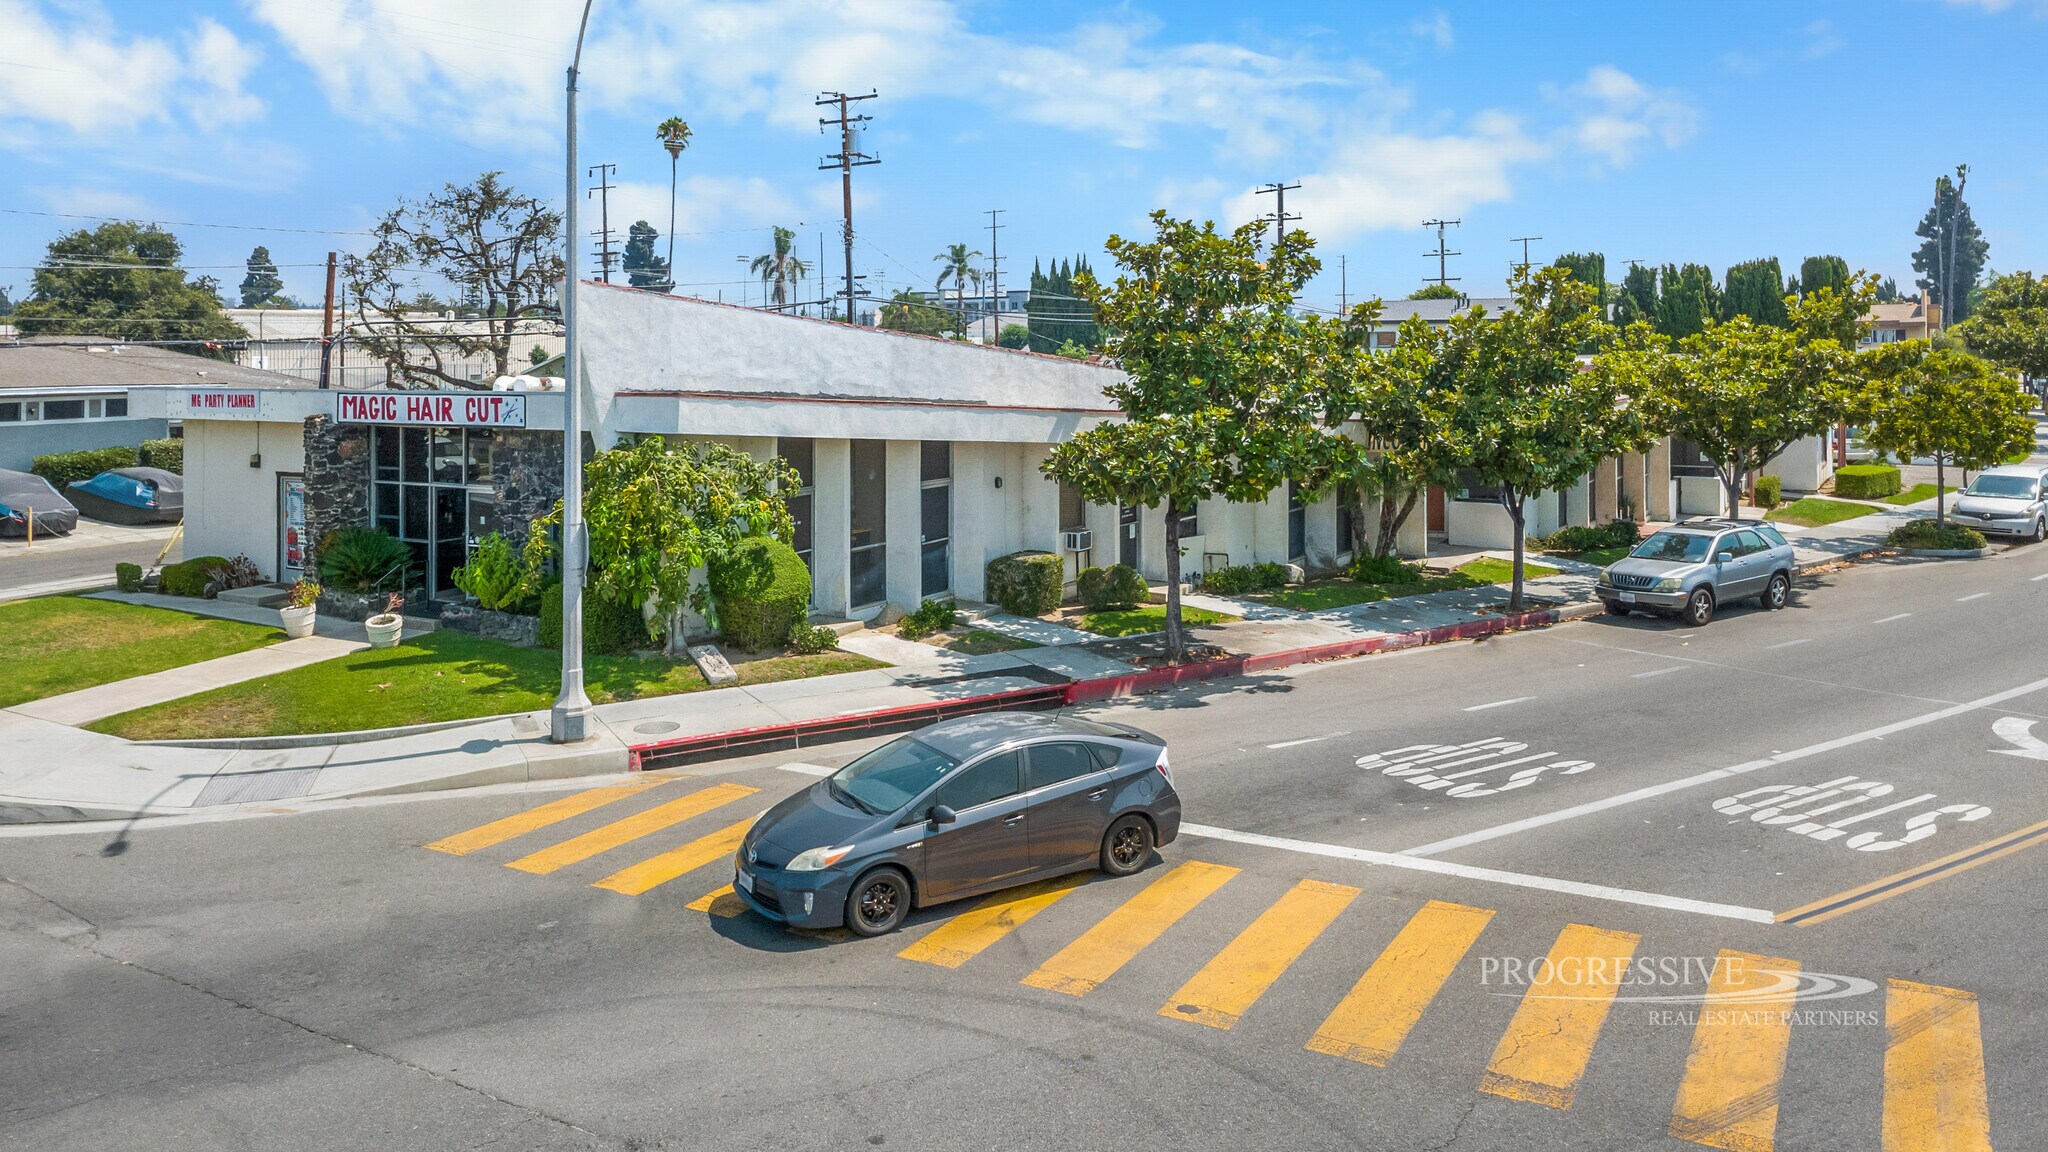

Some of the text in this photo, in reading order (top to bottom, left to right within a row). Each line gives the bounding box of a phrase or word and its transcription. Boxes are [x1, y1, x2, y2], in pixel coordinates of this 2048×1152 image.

[204, 394, 225, 408] PARTY
[227, 394, 255, 408] PLANNER
[342, 395, 503, 423] MAGIC HAIR CUT
[1355, 736, 1596, 798] STOP
[1712, 775, 1992, 851] STOP
